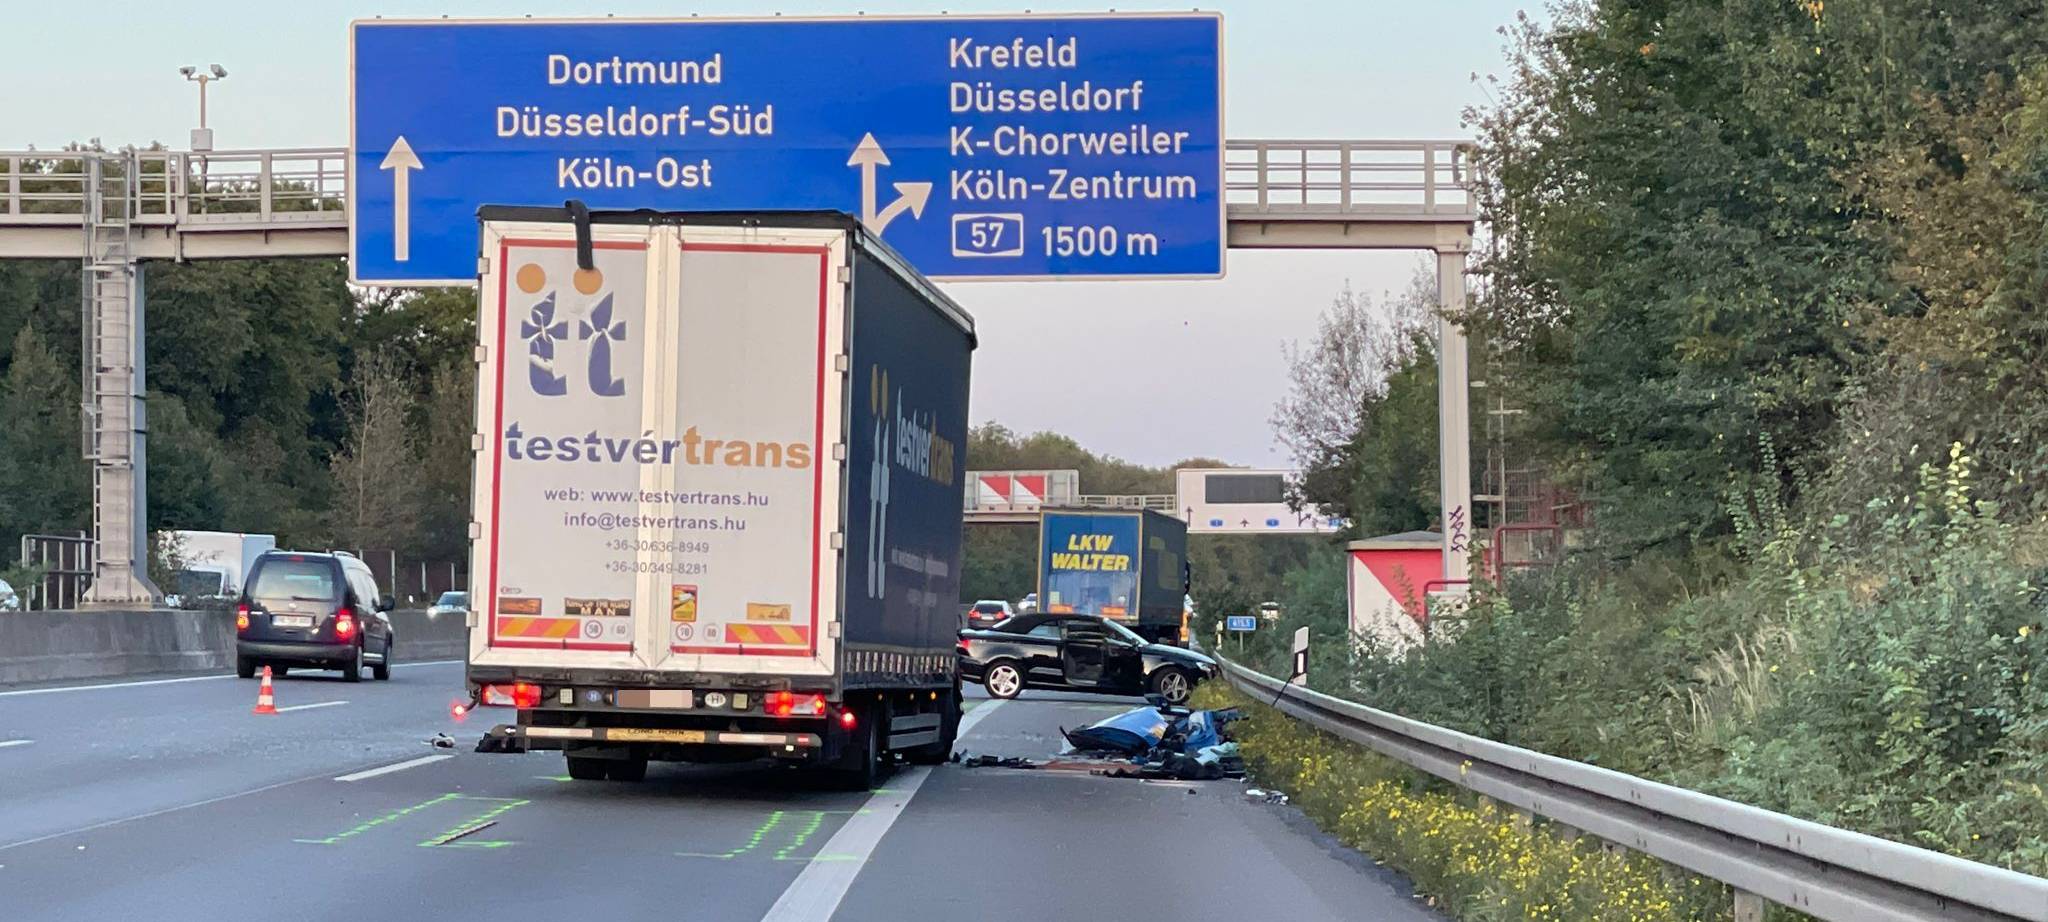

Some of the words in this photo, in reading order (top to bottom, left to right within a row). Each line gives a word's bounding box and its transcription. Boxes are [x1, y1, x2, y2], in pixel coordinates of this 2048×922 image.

[950, 37, 1077, 68] Krefeld
[547, 53, 722, 85] Dortmund
[950, 80, 1143, 113] Düsseldorf
[496, 104, 774, 137] Düsseldorf-Süd
[950, 124, 1190, 156] K-Chorweiler
[557, 156, 713, 188] Köln-Ost
[950, 168, 1197, 201] Köln-Zentrum
[970, 222, 1005, 249] 57
[1041, 225, 1118, 257] 1500
[1126, 231, 1158, 256] m
[504, 421, 812, 470] testvértrans
[544, 487, 585, 502] web:
[590, 488, 769, 507] www.testvertrans.hu
[563, 512, 746, 531] info@testvertrans.hu
[1067, 533, 1114, 551] LKW
[1051, 552, 1130, 571] WALTER
[580, 607, 616, 617] MAN
